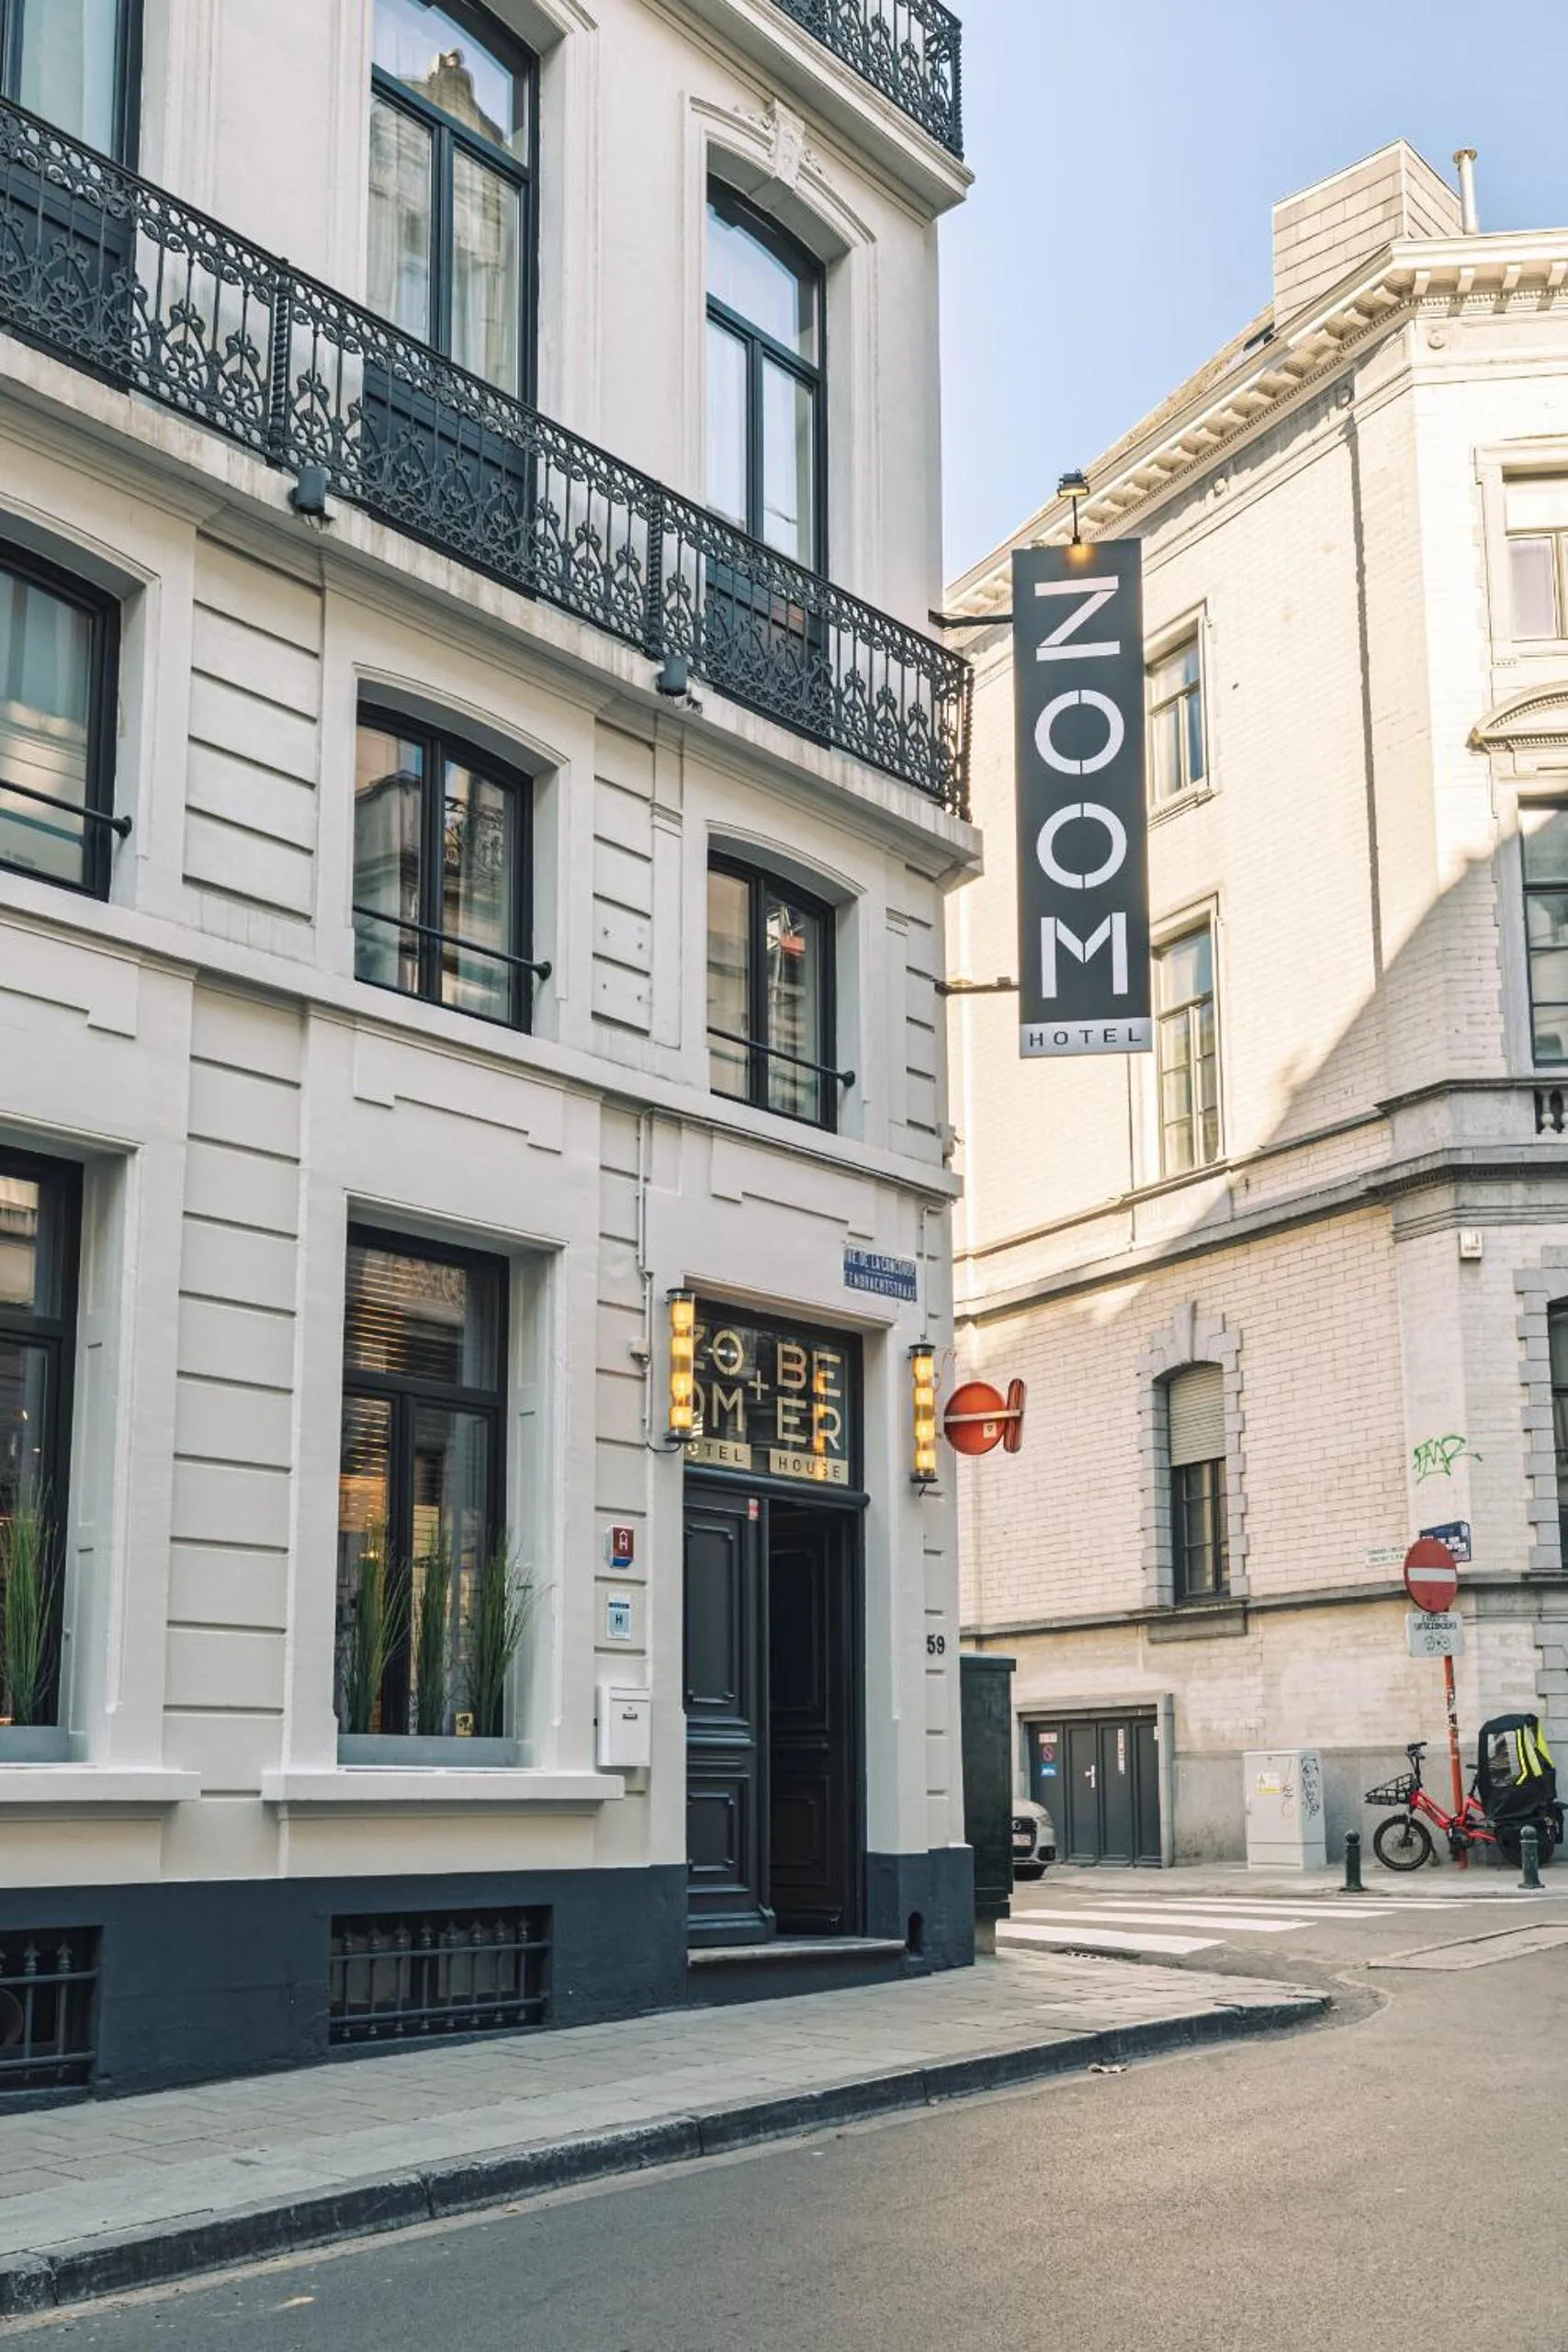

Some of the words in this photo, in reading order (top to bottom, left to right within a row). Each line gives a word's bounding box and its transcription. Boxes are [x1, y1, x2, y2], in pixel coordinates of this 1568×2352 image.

[1034, 575, 1129, 999] ZOOM
[1029, 1028, 1142, 1047] HOTEL
[777, 1343, 841, 1397] BE
[777, 1396, 841, 1450] ER
[926, 1634, 945, 1655] 59
